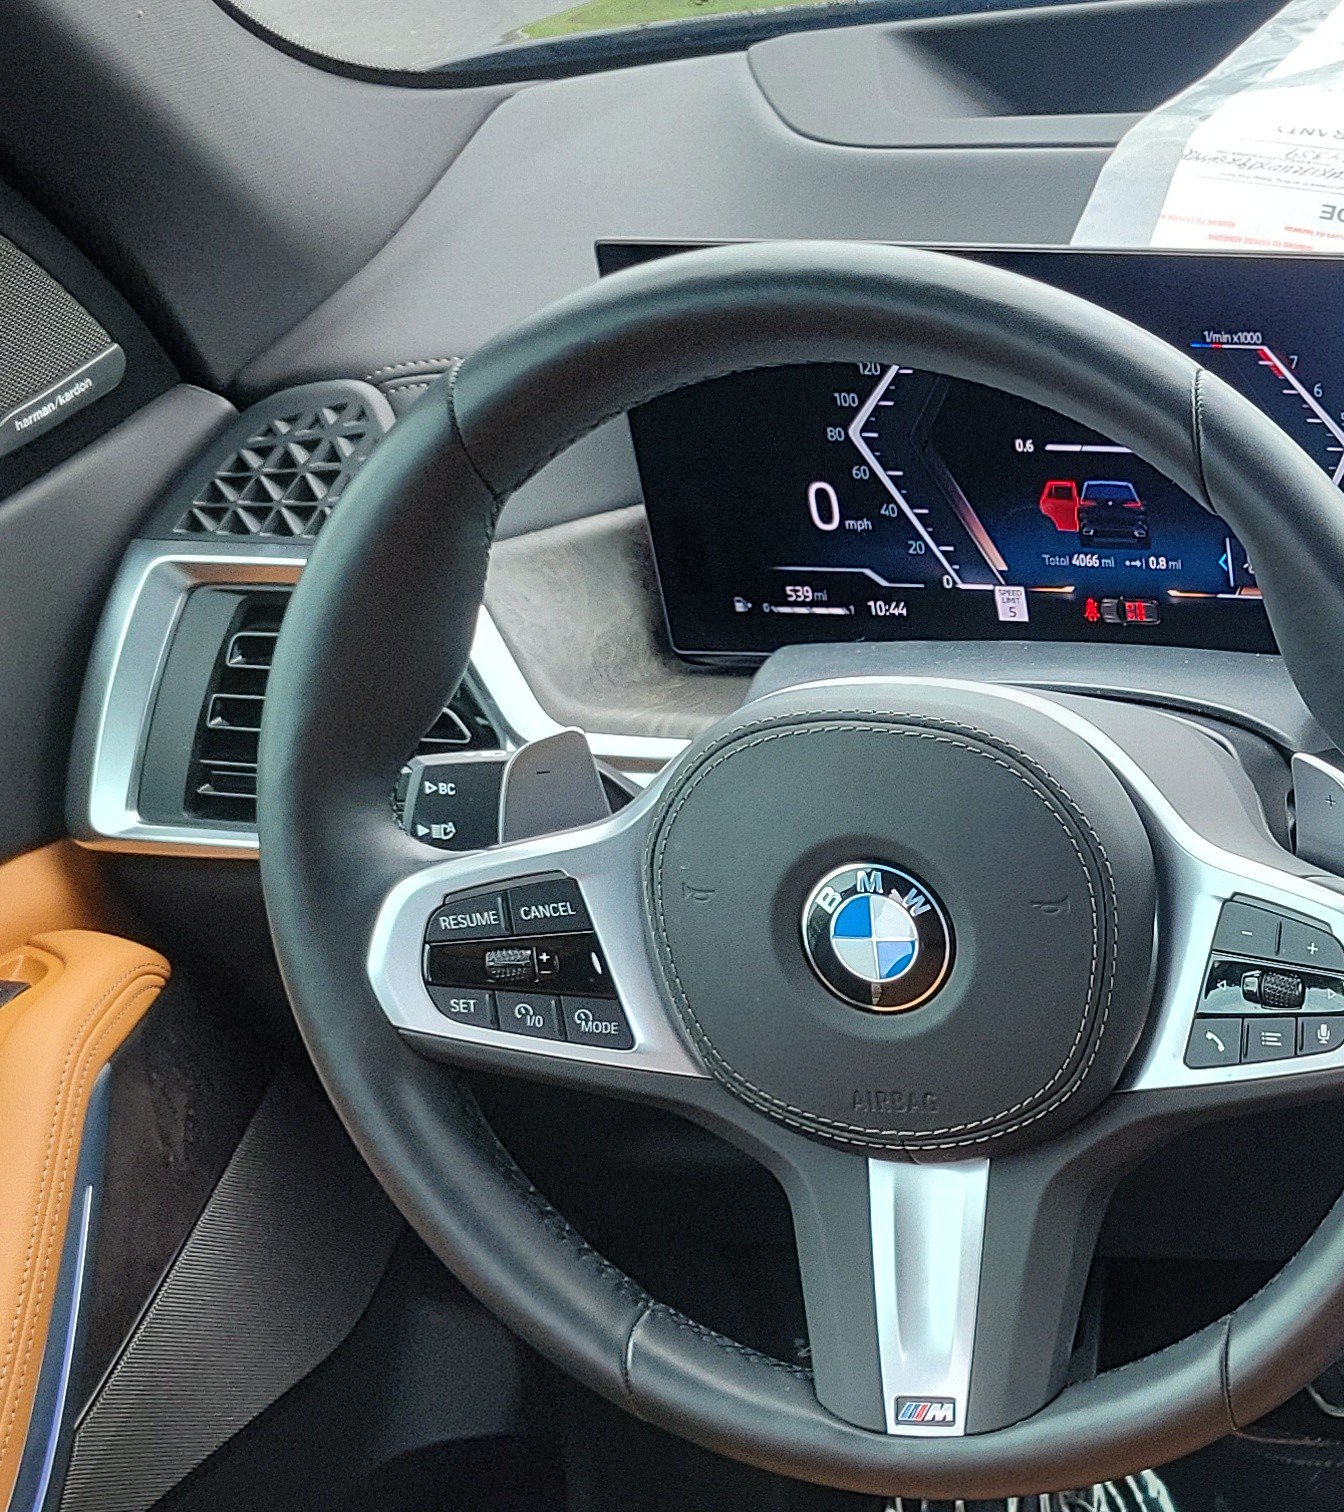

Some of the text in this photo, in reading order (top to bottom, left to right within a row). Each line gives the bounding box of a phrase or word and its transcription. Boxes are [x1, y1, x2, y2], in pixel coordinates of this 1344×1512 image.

[859, 363, 881, 376] 120
[1289, 355, 1298, 370] 7
[1313, 383, 1323, 398] 6
[14, 376, 93, 432] harman/kardon
[834, 392, 858, 407] 100
[827, 427, 845, 441] 80
[1014, 439, 1034, 452] 0.6
[852, 466, 870, 480] 60
[807, 481, 872, 533] 0 mph
[880, 504, 898, 518] 40
[908, 541, 925, 555] 20
[1042, 554, 1070, 567] Total
[1071, 554, 1100, 568] 4066
[1149, 556, 1167, 571] 0.8
[942, 575, 953, 589] 0
[785, 586, 813, 602] 539
[866, 600, 907, 617] 10:44
[1008, 606, 1018, 618] 5
[438, 781, 456, 796] BC
[815, 869, 932, 917] BMW
[520, 901, 577, 921] CANCEL
[439, 910, 499, 931] RESUME
[450, 999, 477, 1014] SET
[581, 1019, 619, 1035] MODE
